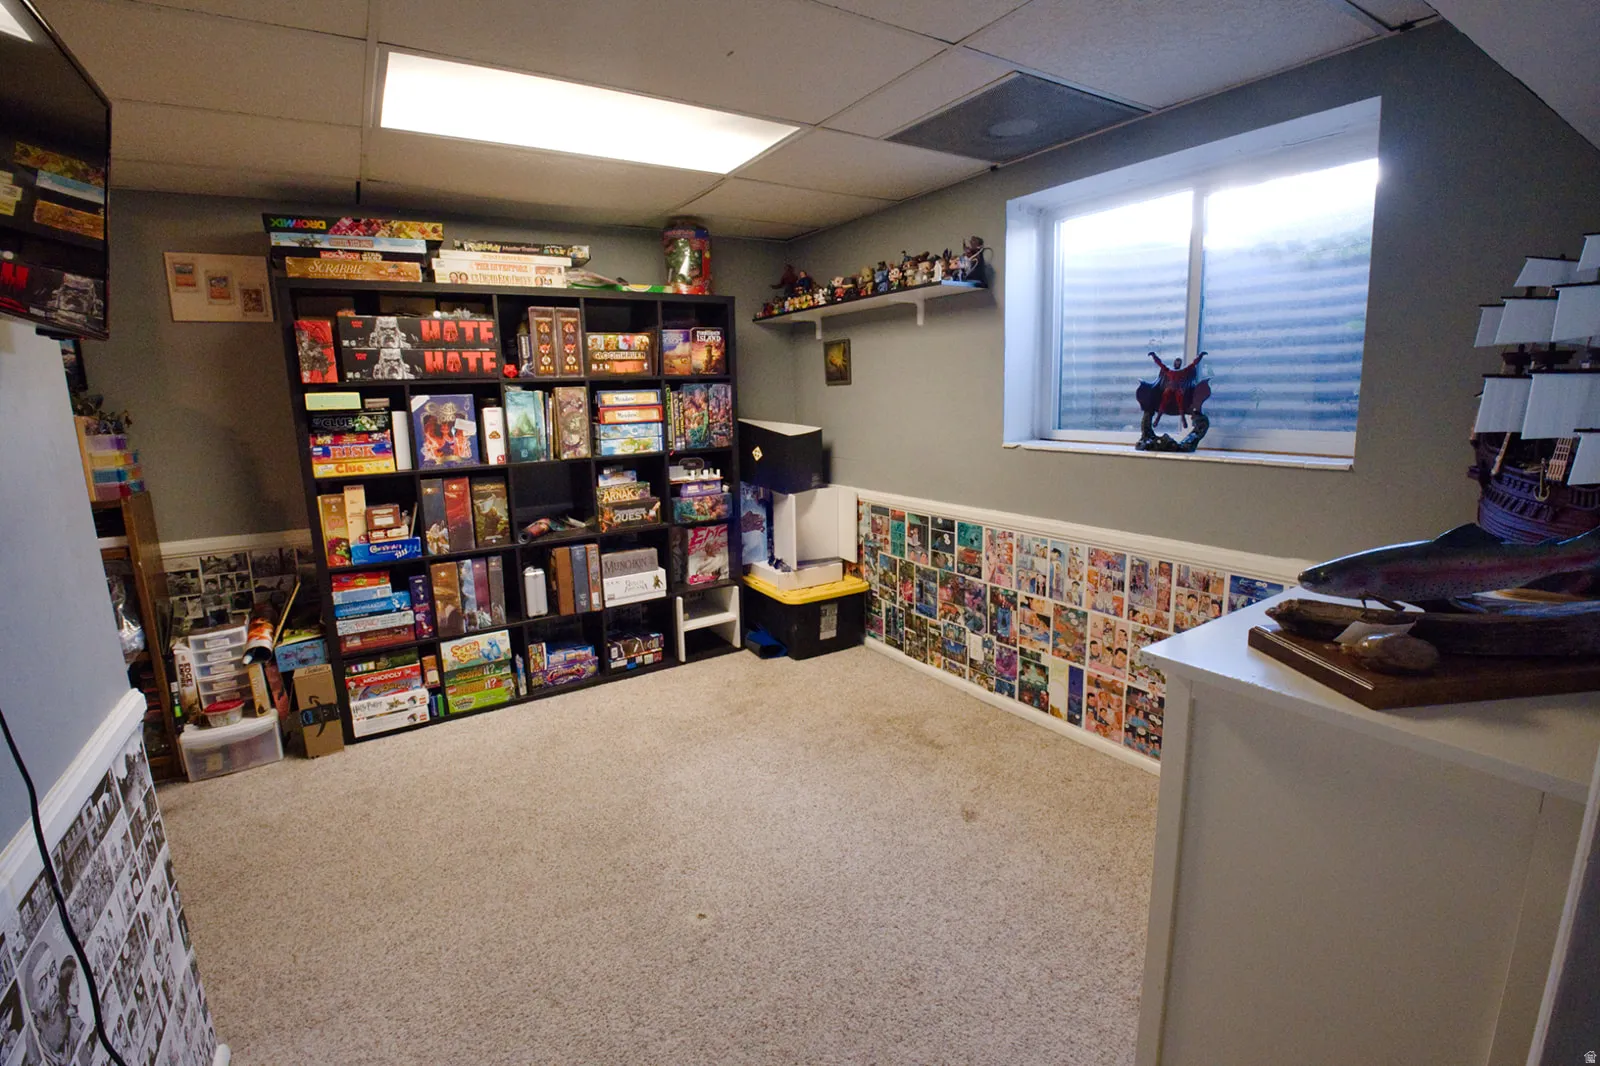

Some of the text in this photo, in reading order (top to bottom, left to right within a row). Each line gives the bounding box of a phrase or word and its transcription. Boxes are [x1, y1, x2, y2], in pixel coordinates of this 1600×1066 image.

[308, 260, 366, 275] SCRABBLE
[420, 320, 494, 343] HATE
[424, 351, 497, 374] HATE
[322, 416, 353, 429] CLUE
[329, 443, 376, 460] RISK
[335, 463, 365, 474] Clue
[602, 487, 635, 503] ARNAK
[613, 511, 647, 523] QUEST
[183, 662, 193, 687] EDGE
[363, 671, 403, 684] MONOPOLY
